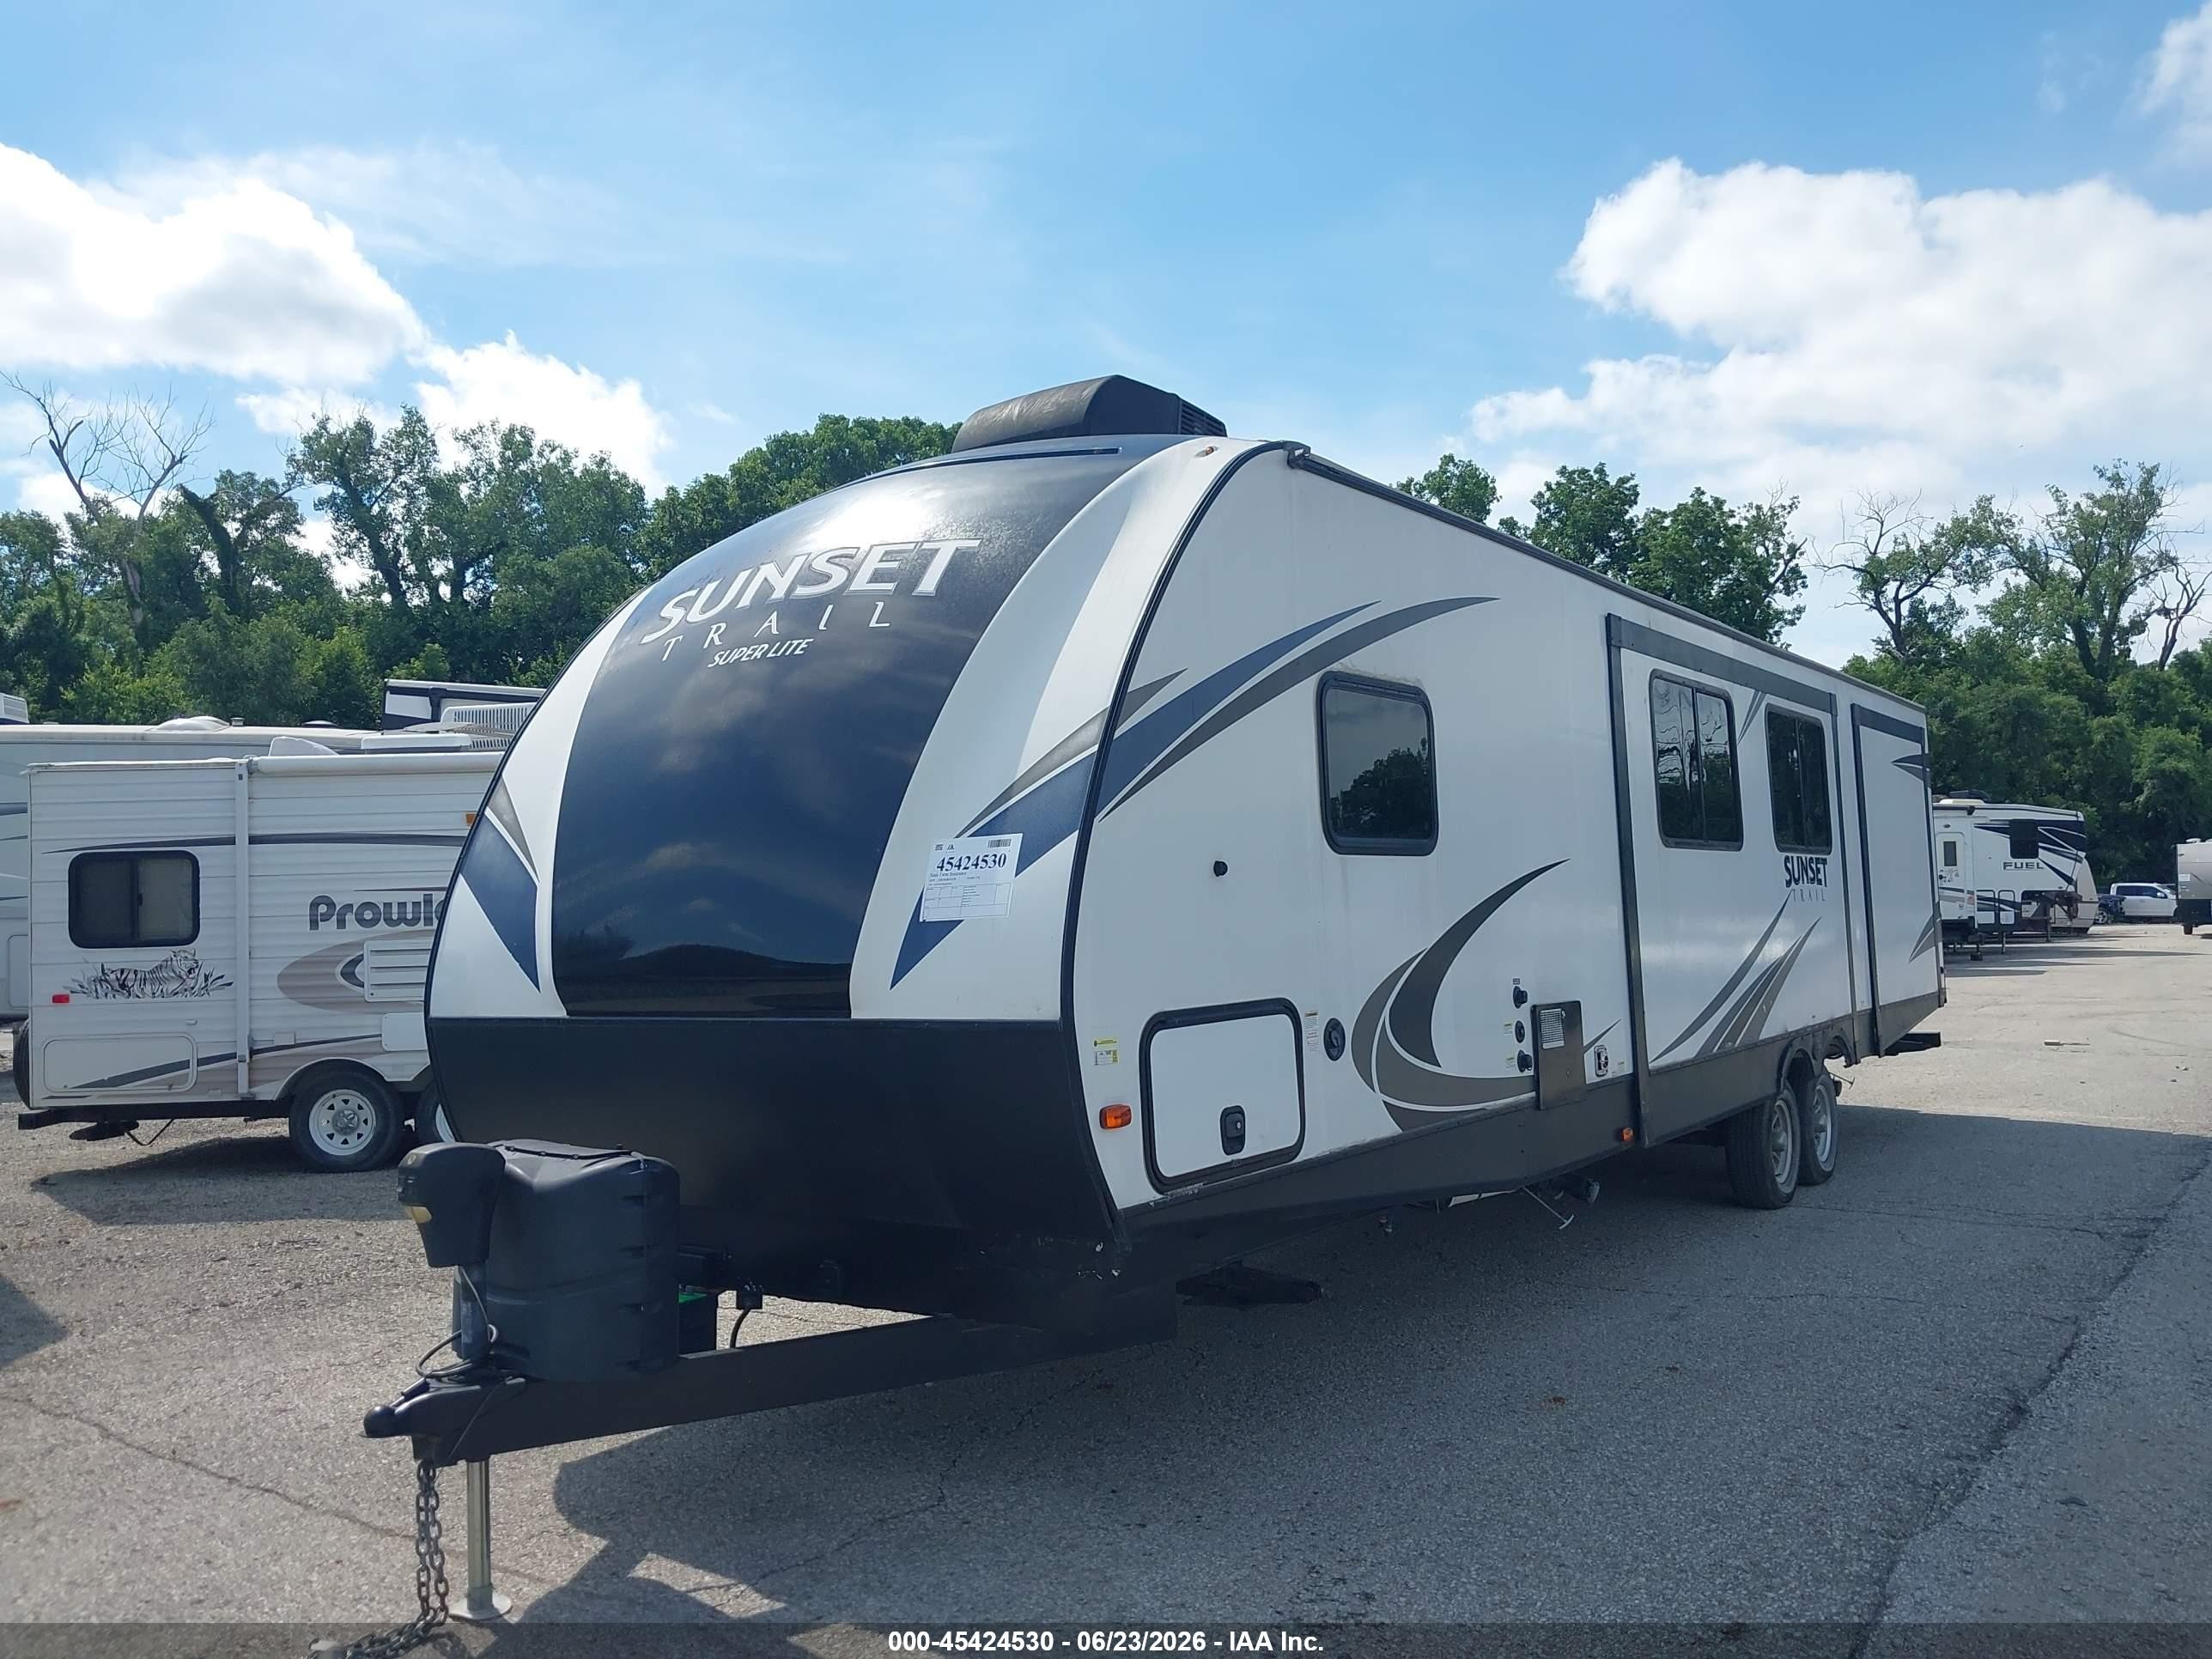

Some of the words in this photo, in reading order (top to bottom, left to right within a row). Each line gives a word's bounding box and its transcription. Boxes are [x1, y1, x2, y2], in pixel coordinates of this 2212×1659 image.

[641, 538, 982, 645] SUNSET
[662, 602, 890, 661] TRAIL
[707, 643, 769, 668] SUPER
[766, 638, 815, 658] LITE
[936, 853, 1007, 872] 45424530
[1784, 855, 1827, 888] SUNSET
[2003, 861, 2044, 871] FUEL
[1792, 889, 1826, 902] TRAIL
